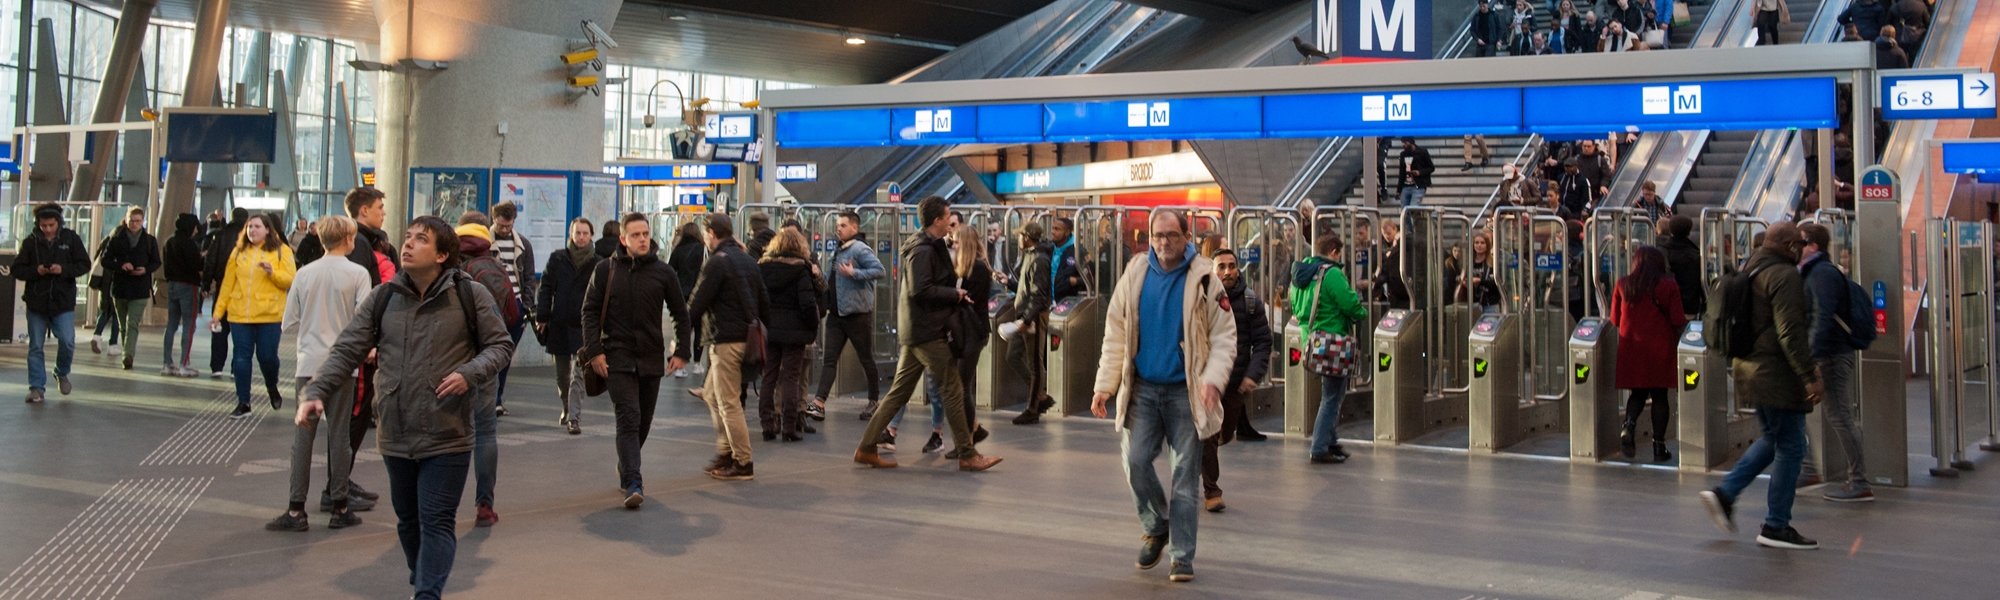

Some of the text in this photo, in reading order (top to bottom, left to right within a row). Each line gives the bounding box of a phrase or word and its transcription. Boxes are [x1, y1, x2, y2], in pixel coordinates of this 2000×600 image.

[1317, 0, 1338, 54] M
[1360, 0, 1415, 52] M
[1392, 102, 1407, 117] M
[1678, 94, 1697, 110] M
[937, 116, 948, 129] M
[1153, 110, 1166, 123] M
[1865, 187, 1889, 198] SOS
